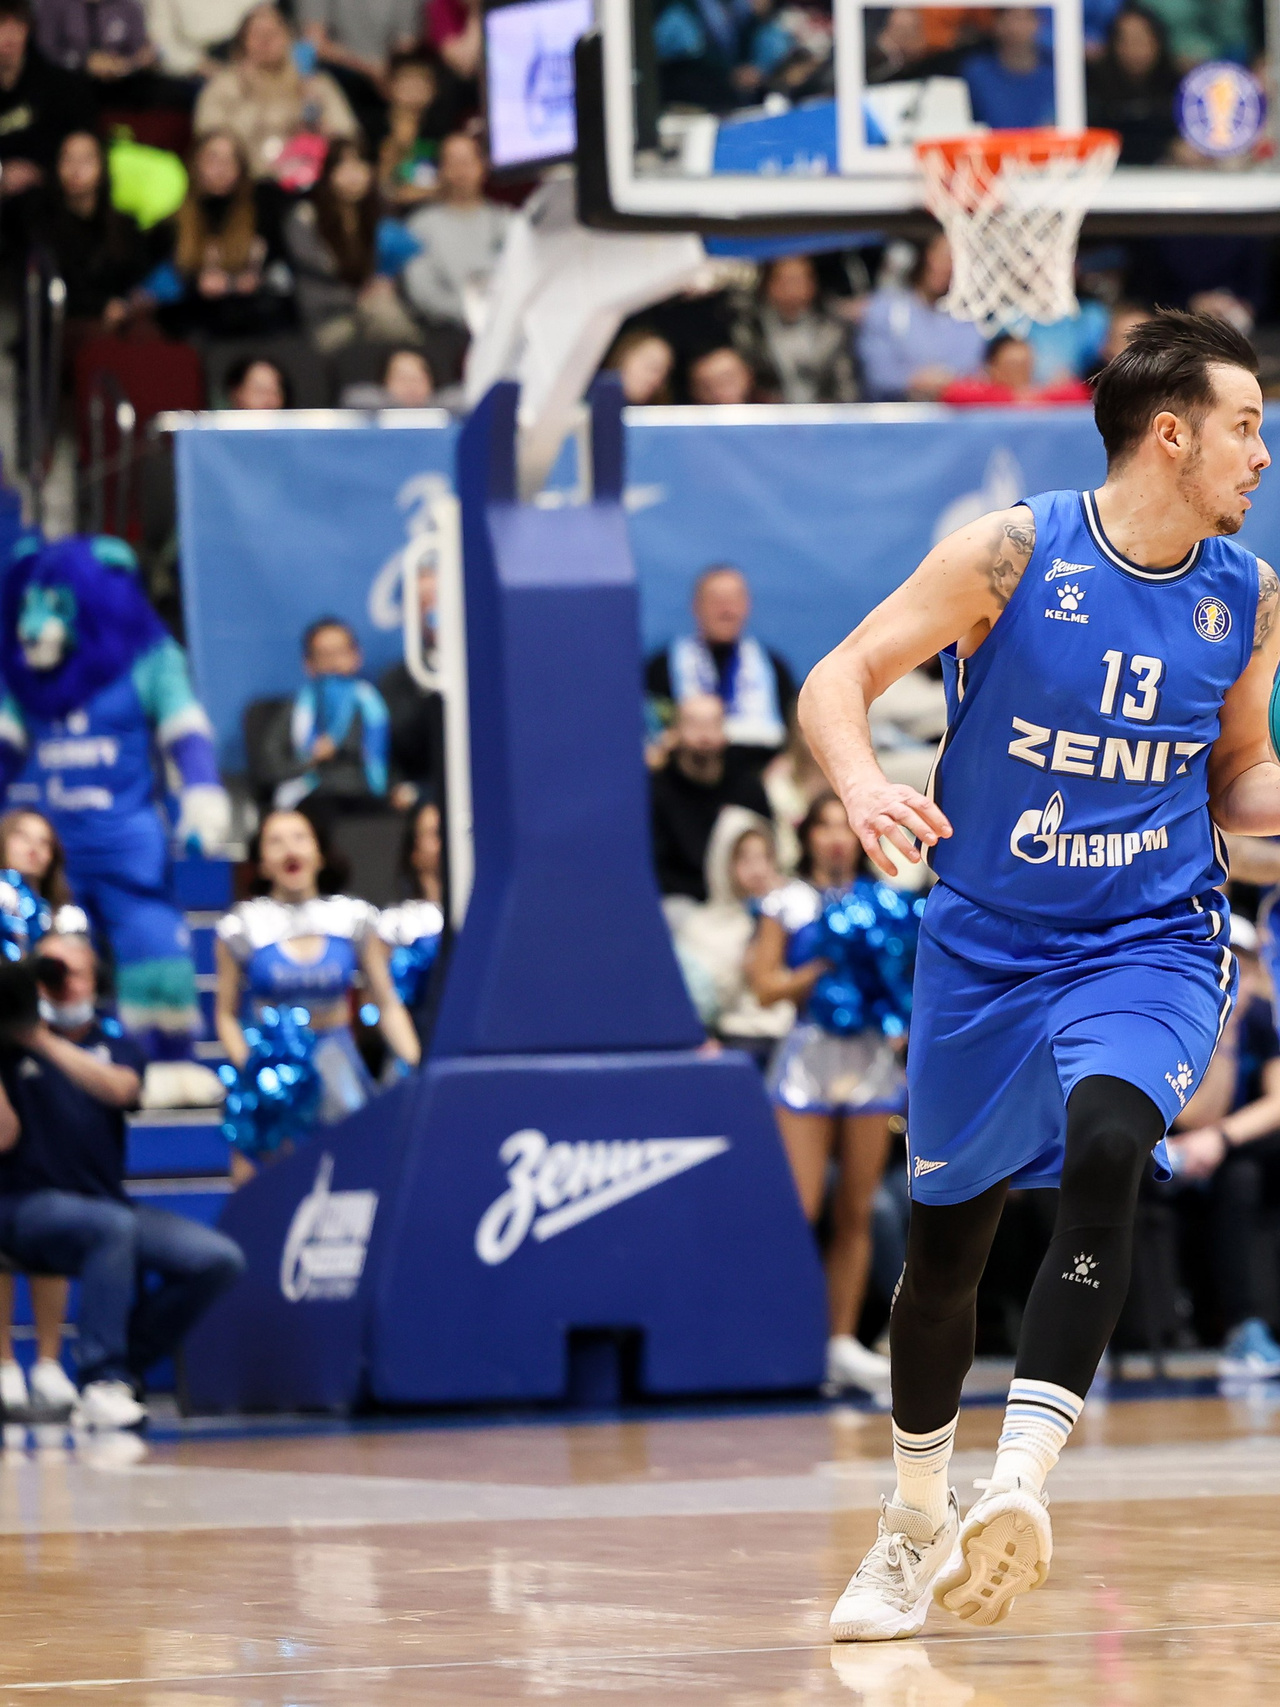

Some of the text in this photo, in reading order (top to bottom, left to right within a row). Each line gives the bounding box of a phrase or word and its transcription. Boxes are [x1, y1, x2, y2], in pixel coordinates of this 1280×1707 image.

[1044, 608, 1090, 624] KELME
[1099, 648, 1164, 722] 13
[1007, 715, 1209, 784] ZENIT
[1061, 1271, 1101, 1289] KELME
